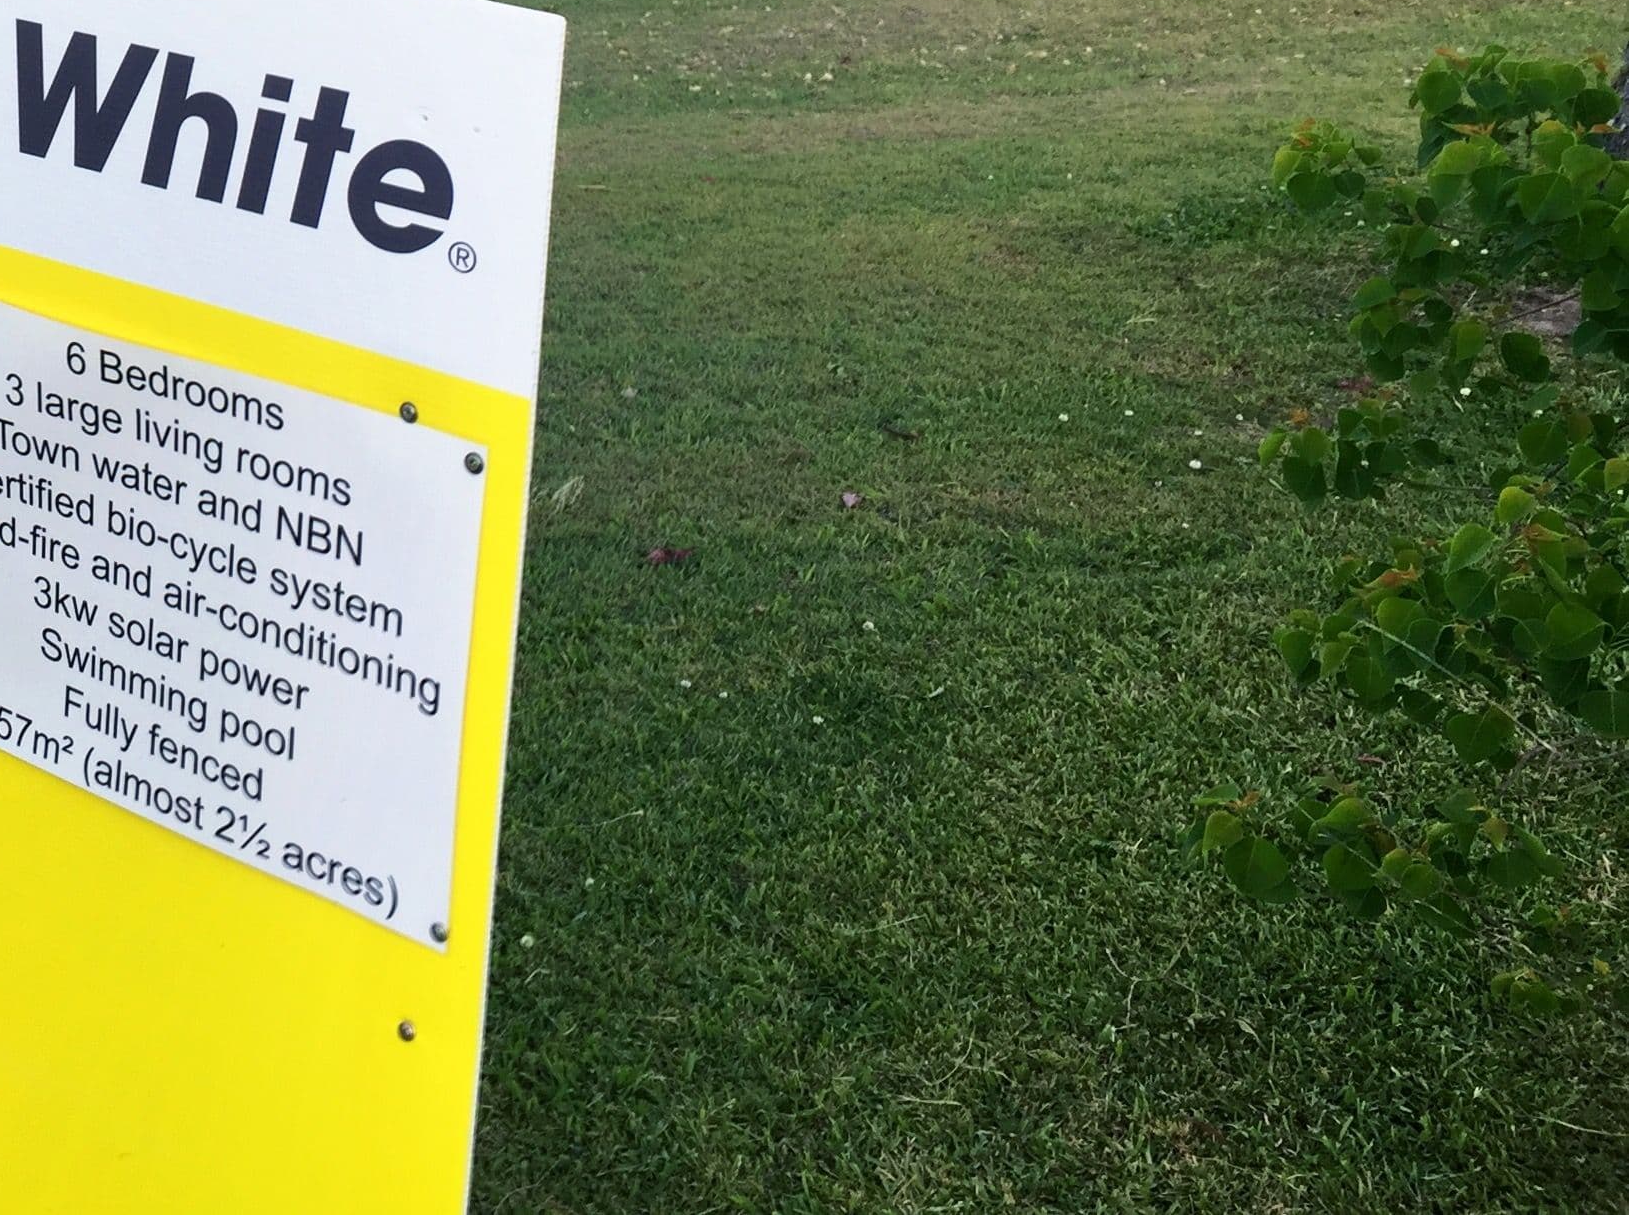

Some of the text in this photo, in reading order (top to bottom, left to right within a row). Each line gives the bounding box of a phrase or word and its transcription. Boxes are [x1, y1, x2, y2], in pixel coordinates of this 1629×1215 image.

[6, 373, 351, 506] 3 large living rooms
[67, 342, 284, 430] 6 Bedrooms
[92, 453, 187, 505] water
[198, 490, 262, 533] and
[277, 506, 363, 566] NBN
[108, 500, 257, 584] bio-cycle
[270, 568, 402, 637] system
[34, 576, 309, 709] 3kw solar power
[41, 628, 294, 760] Swimming pool
[92, 555, 151, 598] and
[164, 581, 440, 716] air-conditioning
[65, 685, 263, 801] Fully fenced
[84, 747, 204, 830] (almost
[215, 806, 270, 859] 2½
[283, 843, 398, 919] acres)
